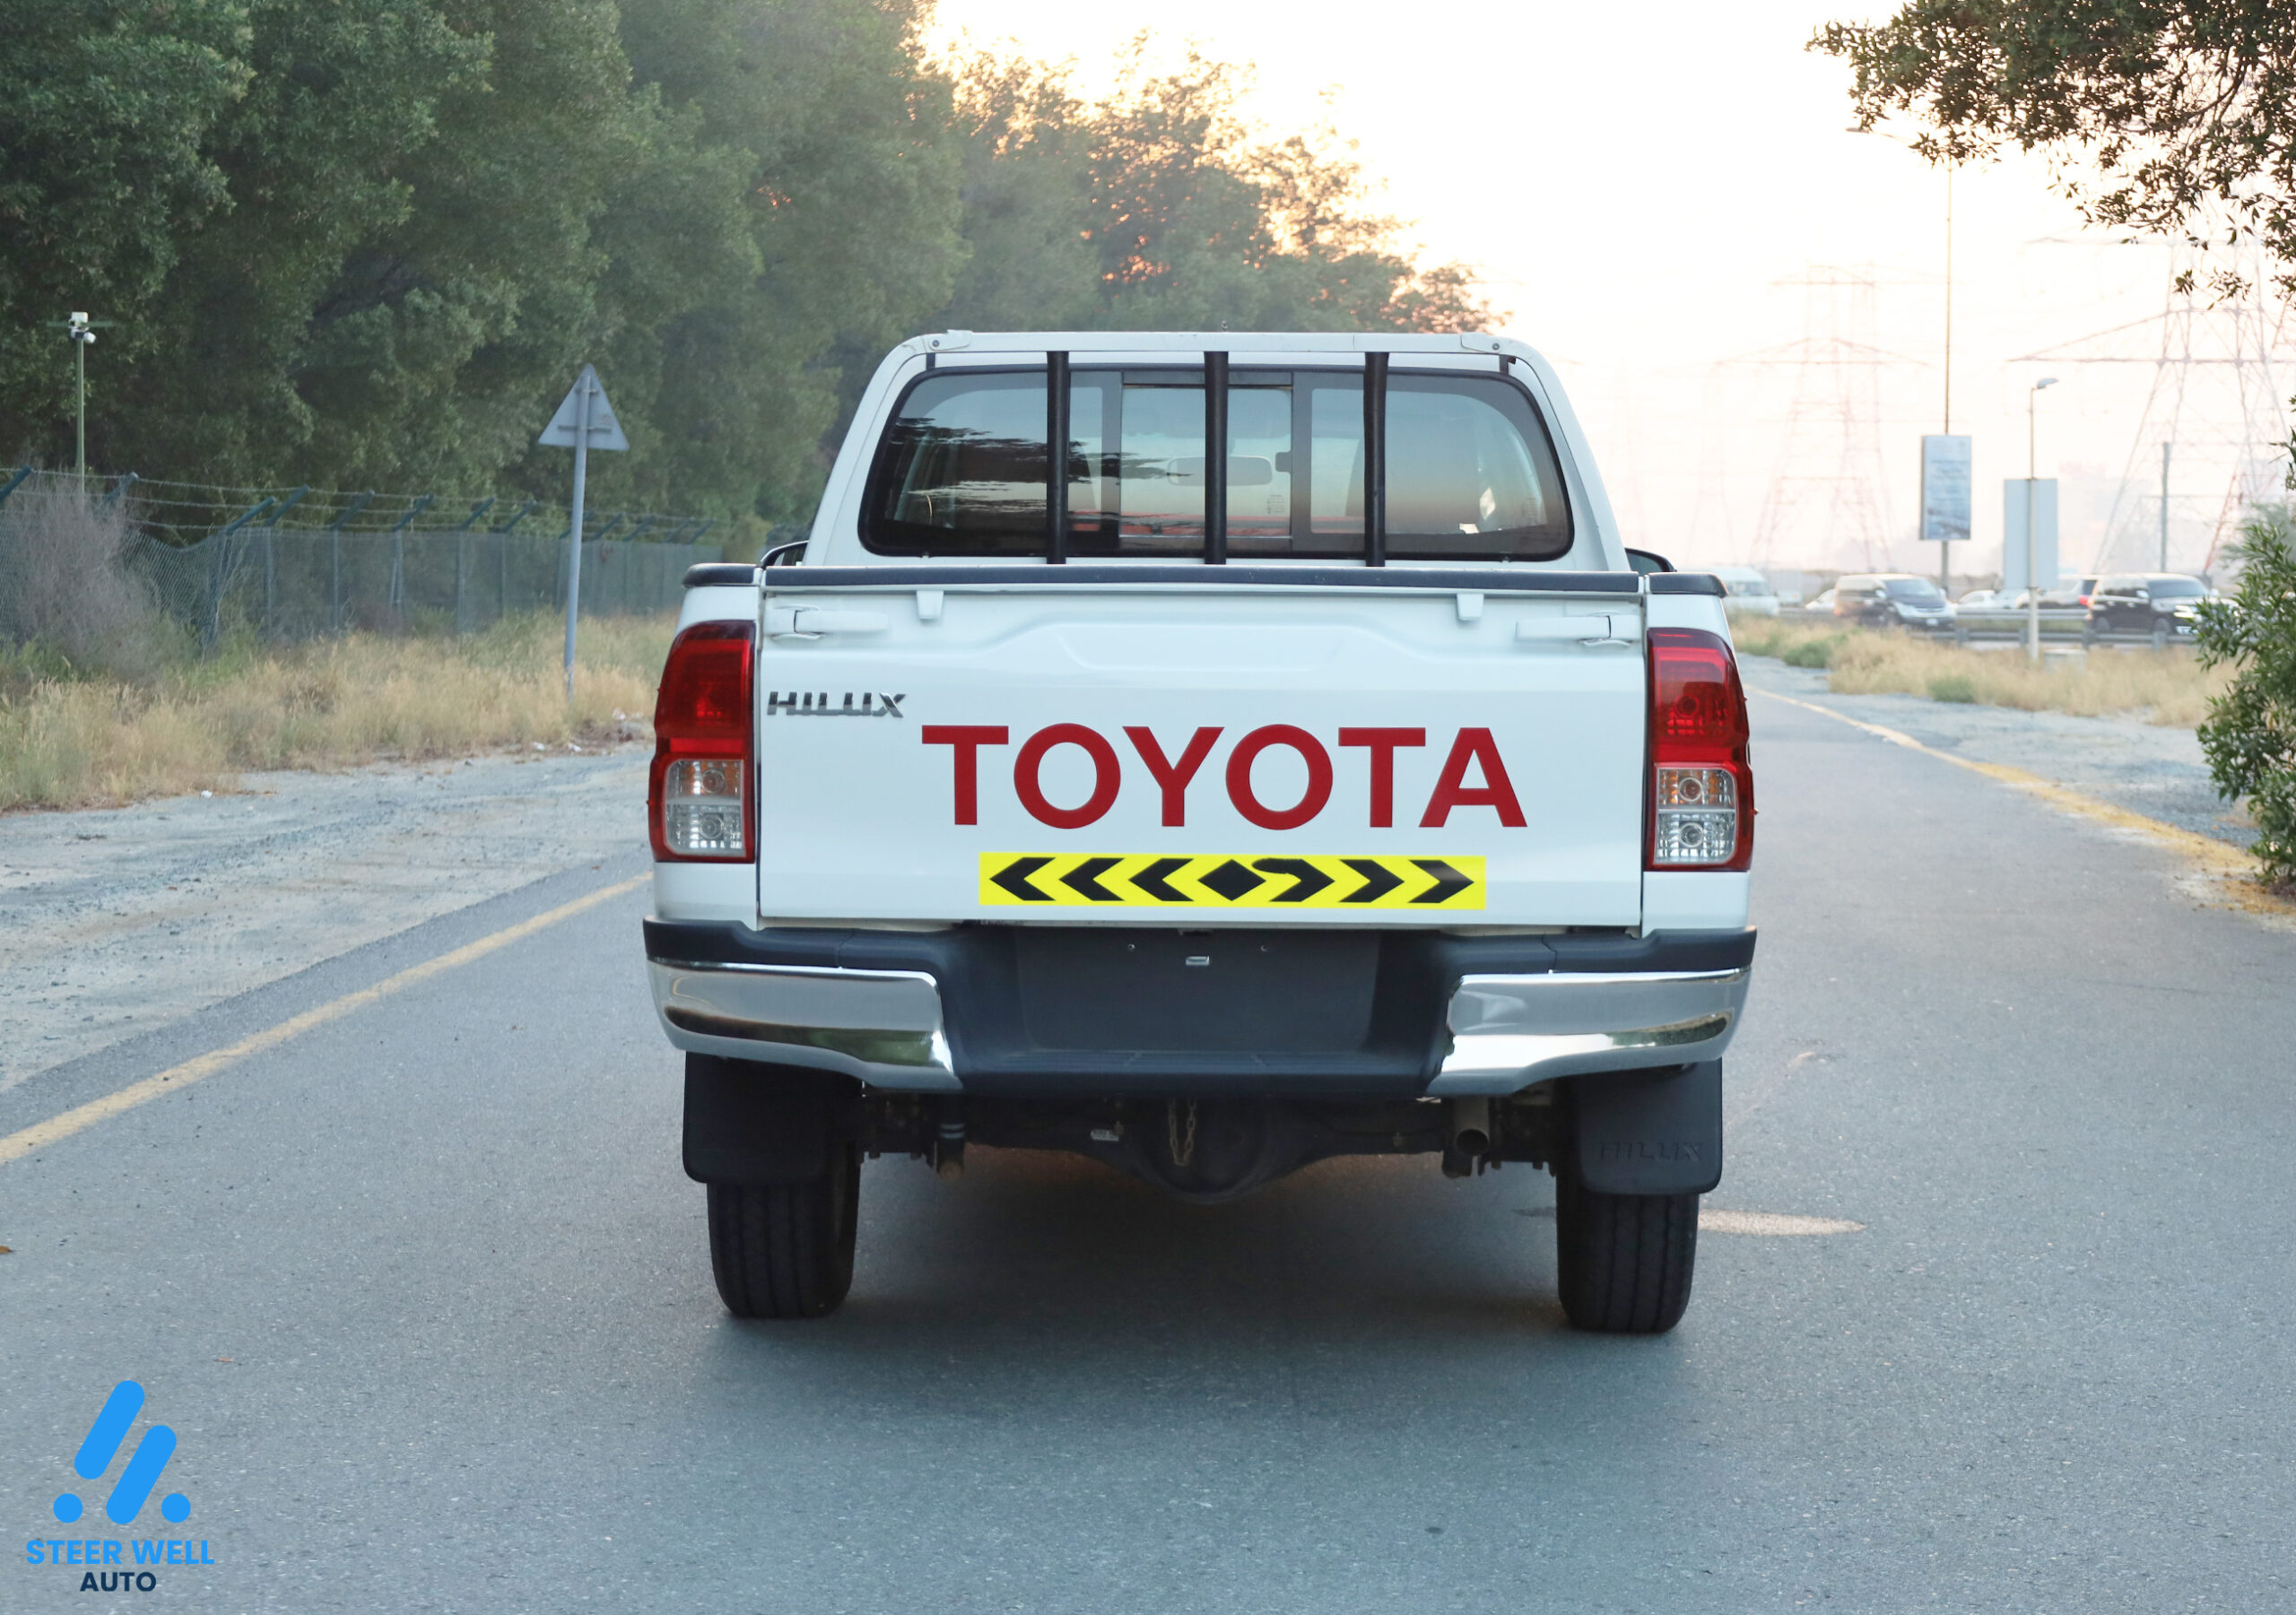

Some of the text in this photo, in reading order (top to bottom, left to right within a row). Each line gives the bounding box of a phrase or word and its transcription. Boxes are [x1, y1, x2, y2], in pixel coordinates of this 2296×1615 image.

[767, 690, 907, 718] HILUX
[922, 723, 1527, 830] TOYOTA
[1598, 1141, 1705, 1162] HILUX
